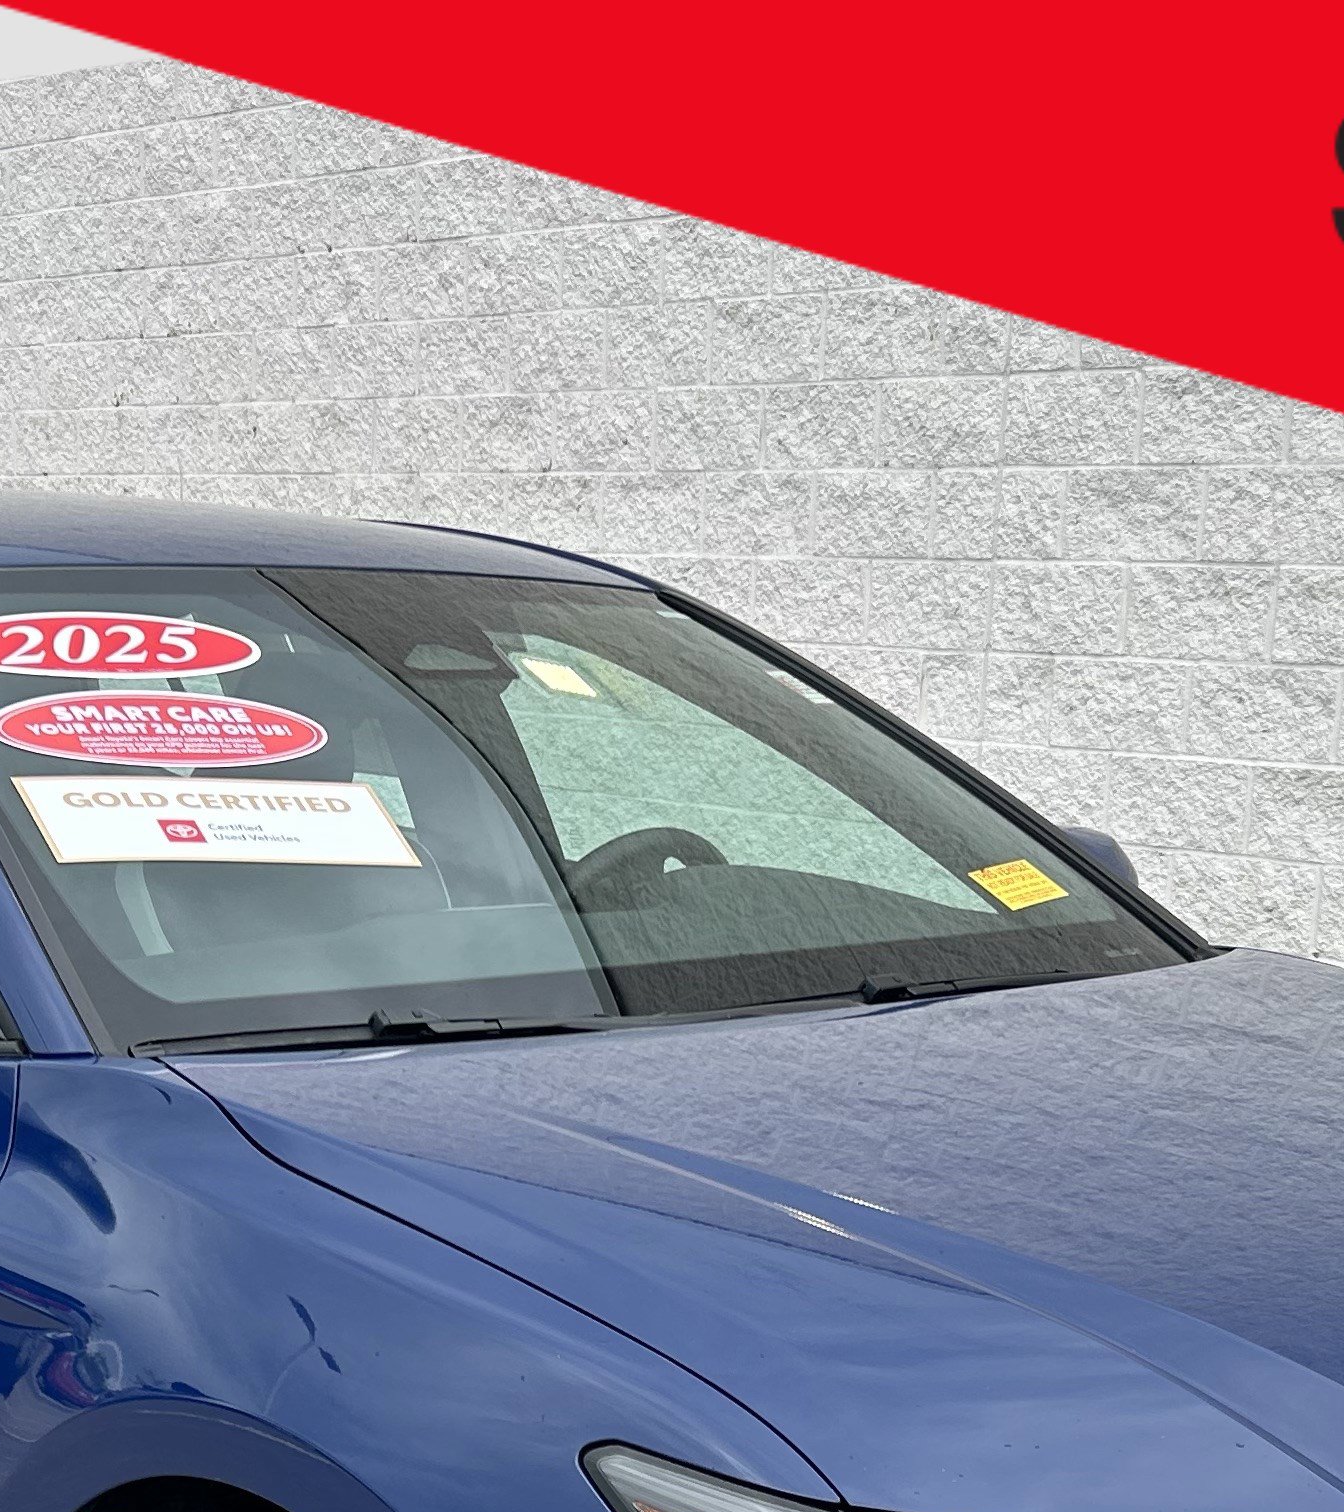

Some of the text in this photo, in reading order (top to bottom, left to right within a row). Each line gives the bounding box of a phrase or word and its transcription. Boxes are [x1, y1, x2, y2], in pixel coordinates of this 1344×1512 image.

[1, 624, 198, 665] 2025
[50, 705, 252, 724] SMART CARE
[24, 722, 91, 736] YOUR
[89, 722, 149, 735] FIRST
[220, 724, 257, 736] ON
[62, 791, 352, 813] GOLD CERTIFIED
[208, 822, 263, 832] Certified
[213, 832, 301, 843] Used Vehicles
